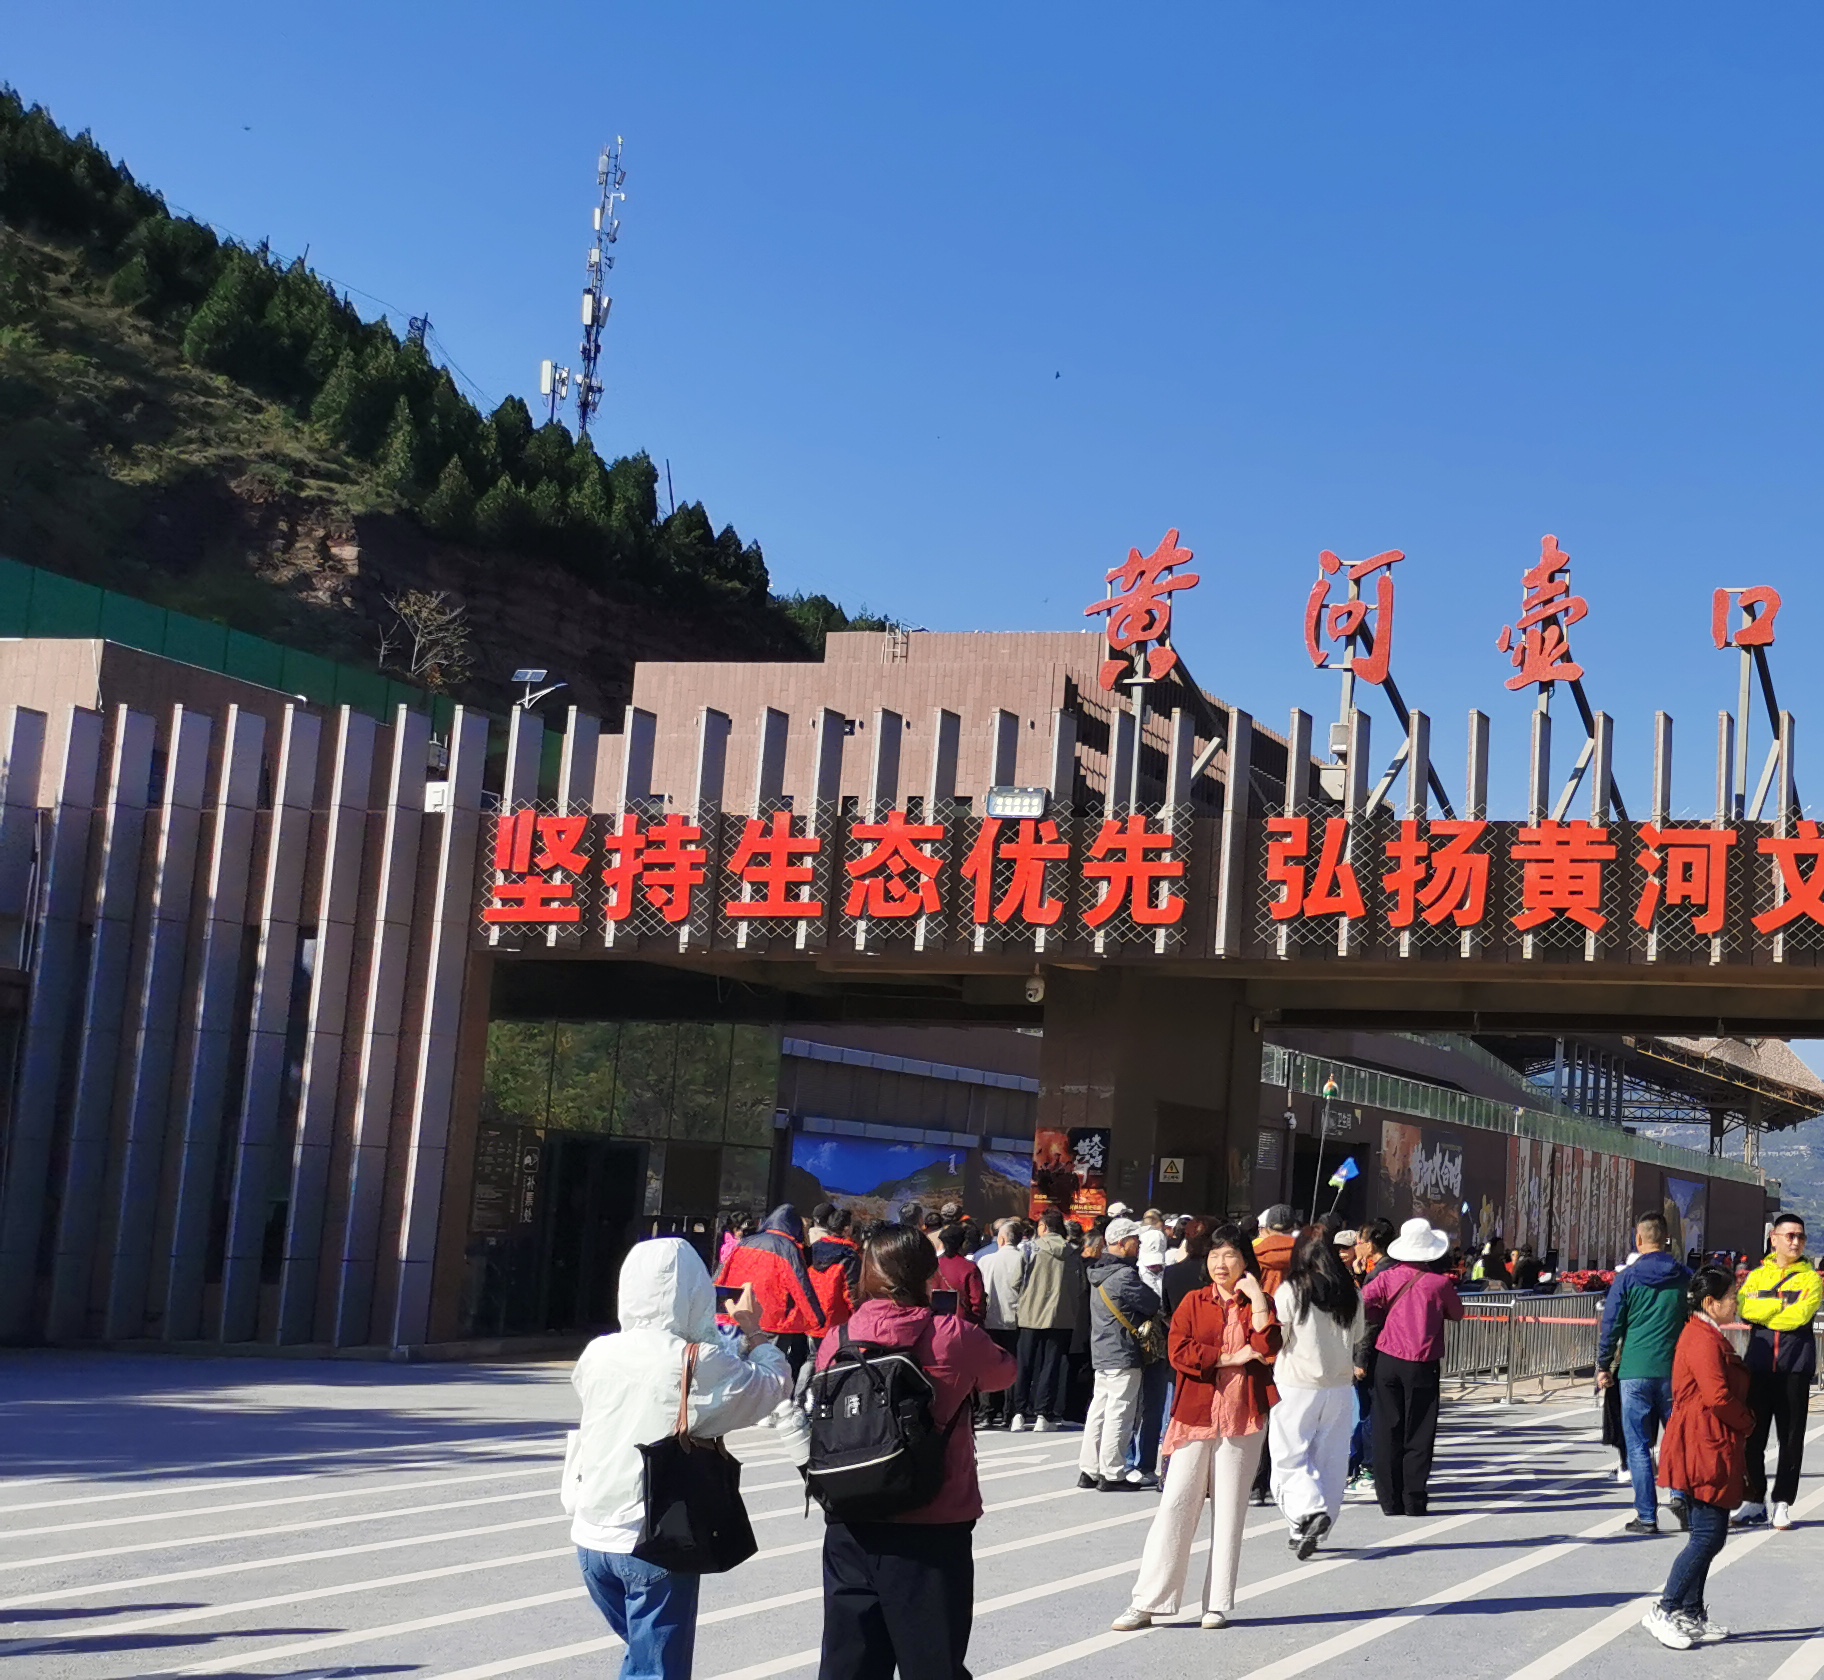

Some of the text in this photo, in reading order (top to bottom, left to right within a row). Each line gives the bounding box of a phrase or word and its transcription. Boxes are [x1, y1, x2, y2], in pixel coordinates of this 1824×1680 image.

[482, 810, 1187, 927] 坚持生态优先
